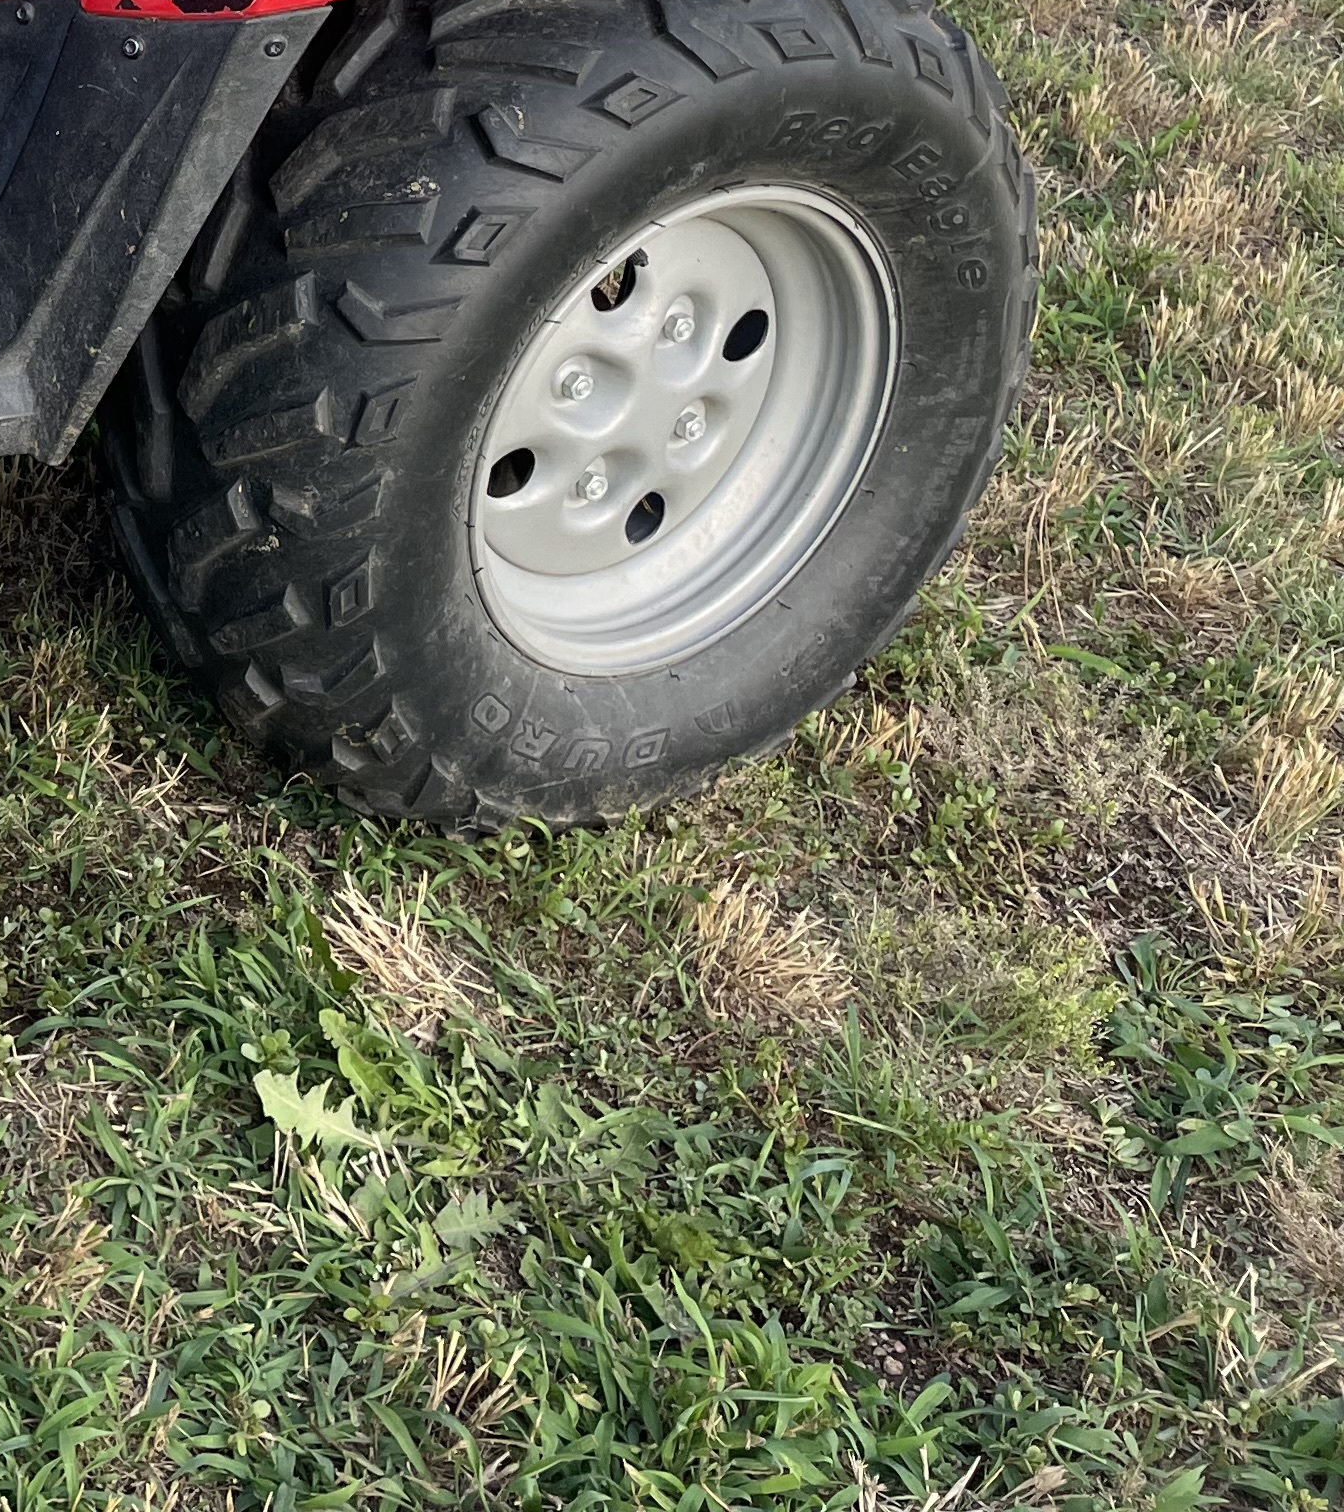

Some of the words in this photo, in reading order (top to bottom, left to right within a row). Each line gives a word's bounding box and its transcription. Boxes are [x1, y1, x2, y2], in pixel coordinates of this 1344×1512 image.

[766, 111, 893, 153] Red
[890, 142, 989, 290] Eagle
[470, 691, 672, 772] DURO
